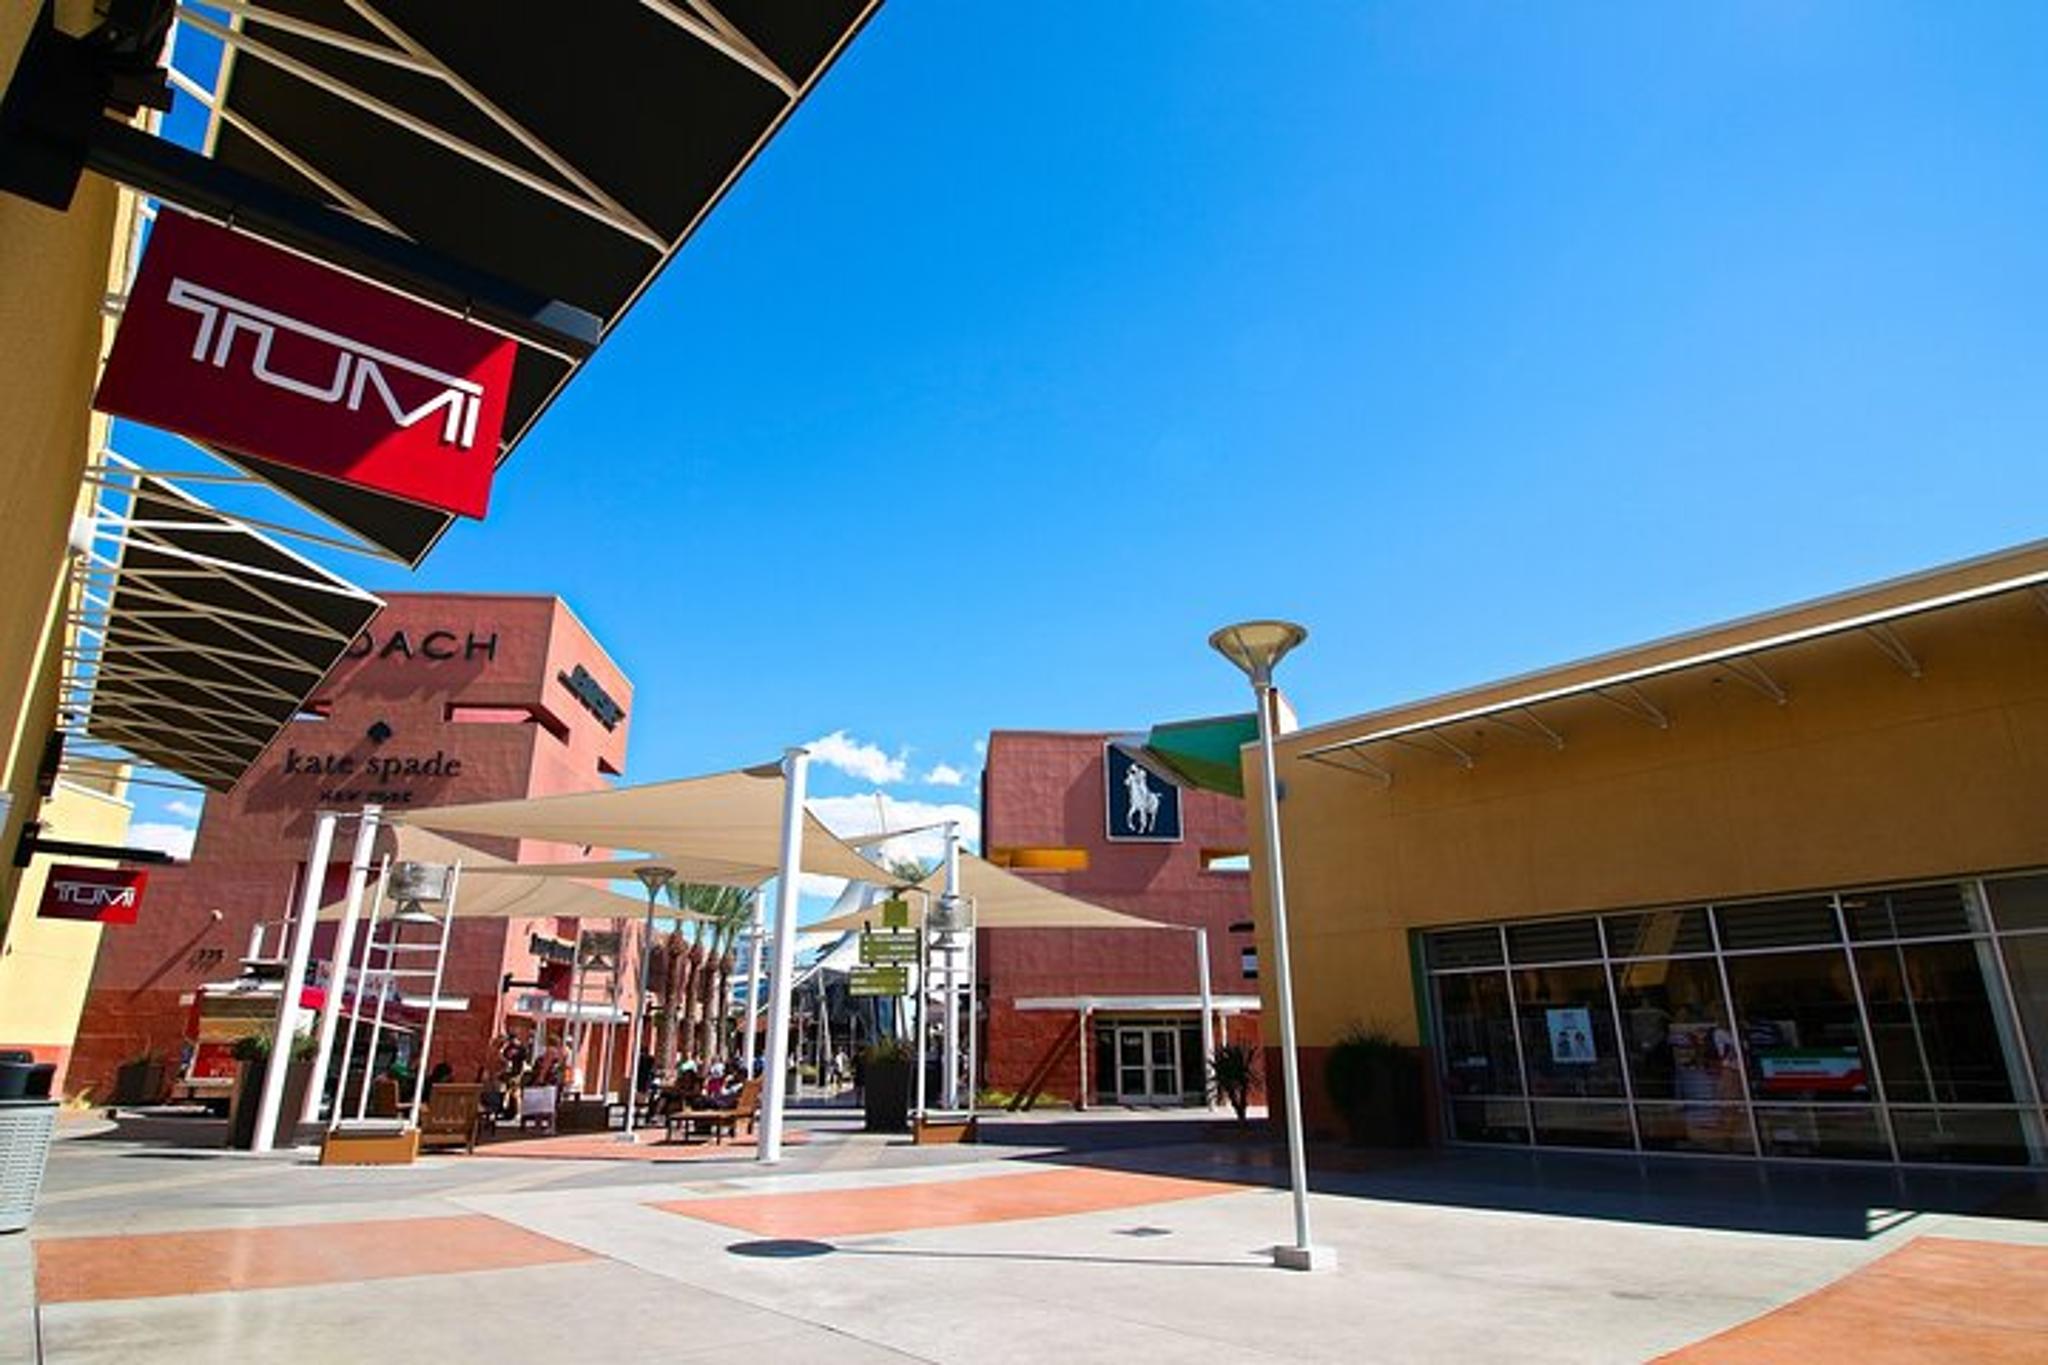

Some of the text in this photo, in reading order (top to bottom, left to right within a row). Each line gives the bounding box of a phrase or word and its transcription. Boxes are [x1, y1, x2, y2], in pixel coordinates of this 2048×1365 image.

[167, 278, 484, 448] TUMI
[347, 630, 498, 661] OACH
[284, 748, 462, 784] kate spade
[53, 880, 136, 908] TUMI
